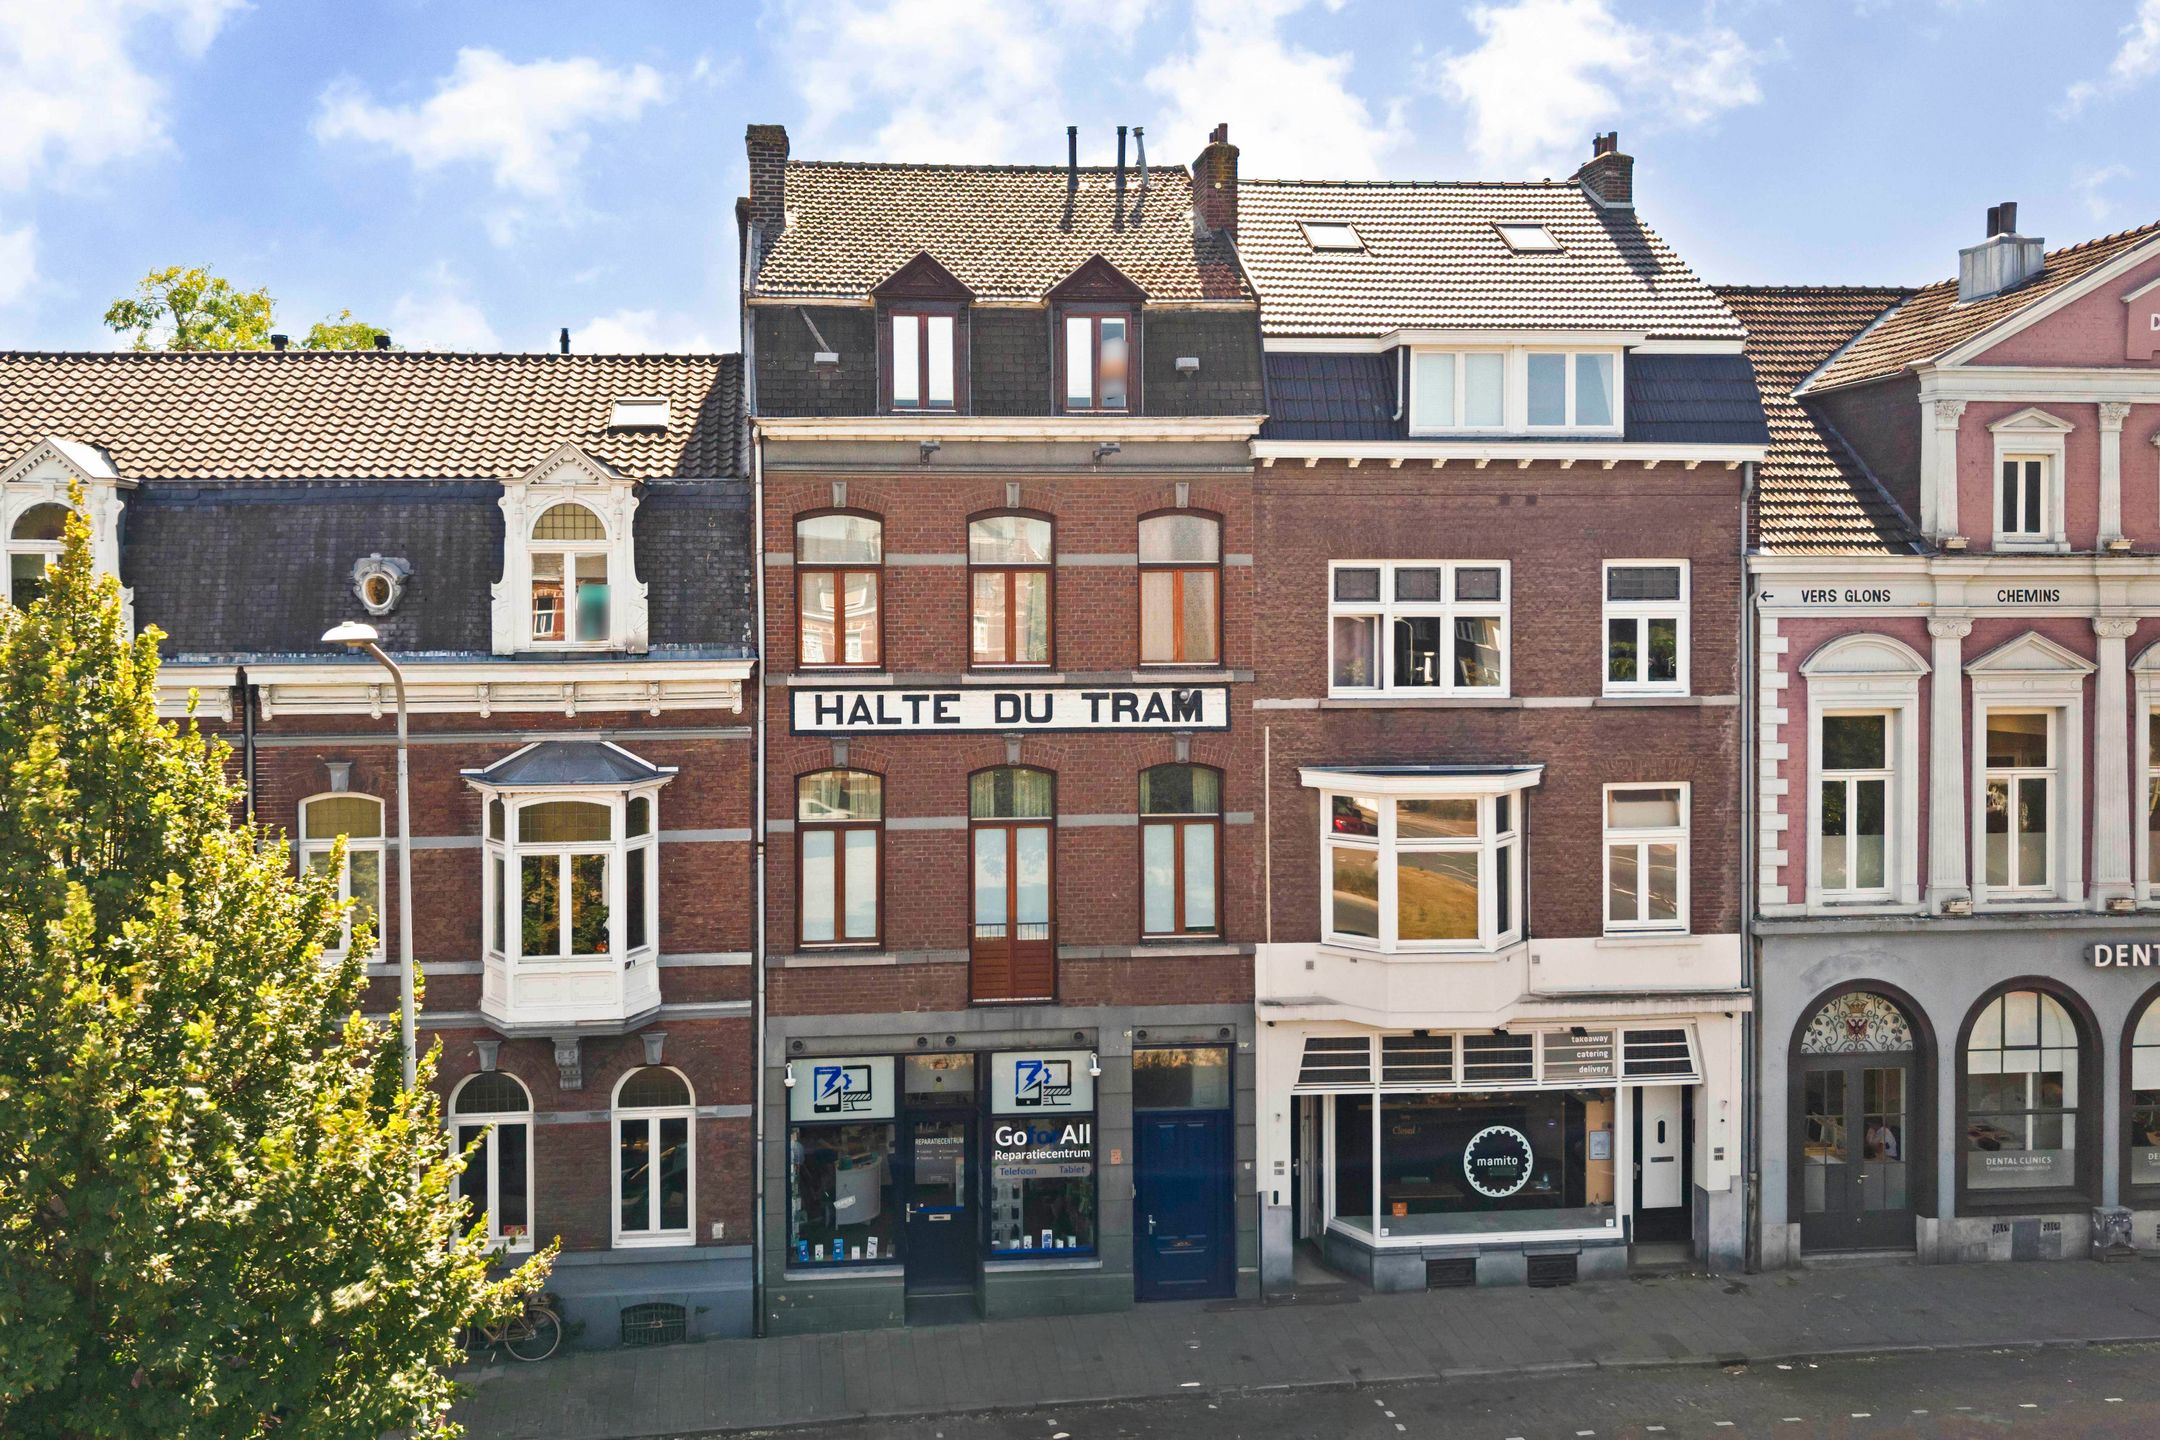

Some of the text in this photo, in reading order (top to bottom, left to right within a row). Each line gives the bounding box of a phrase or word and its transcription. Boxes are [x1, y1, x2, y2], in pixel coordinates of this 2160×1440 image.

[1801, 589, 1891, 603] VERS GLONS
[1997, 589, 2060, 603] CHEMINS
[815, 690, 1203, 726] HALTE DU TRAM
[1571, 1035, 1608, 1043] takeaway
[1576, 1050, 1609, 1059] catering
[1578, 1065, 1609, 1074] delivery
[915, 1137, 964, 1145] REPARATIECENTRUM
[994, 1148, 1091, 1162] Reparatiecentrum
[1476, 1155, 1518, 1167] mamito
[1985, 1156, 2052, 1166] DENTAL CLINICS
[1000, 1165, 1085, 1176] Telefoon Tablet
